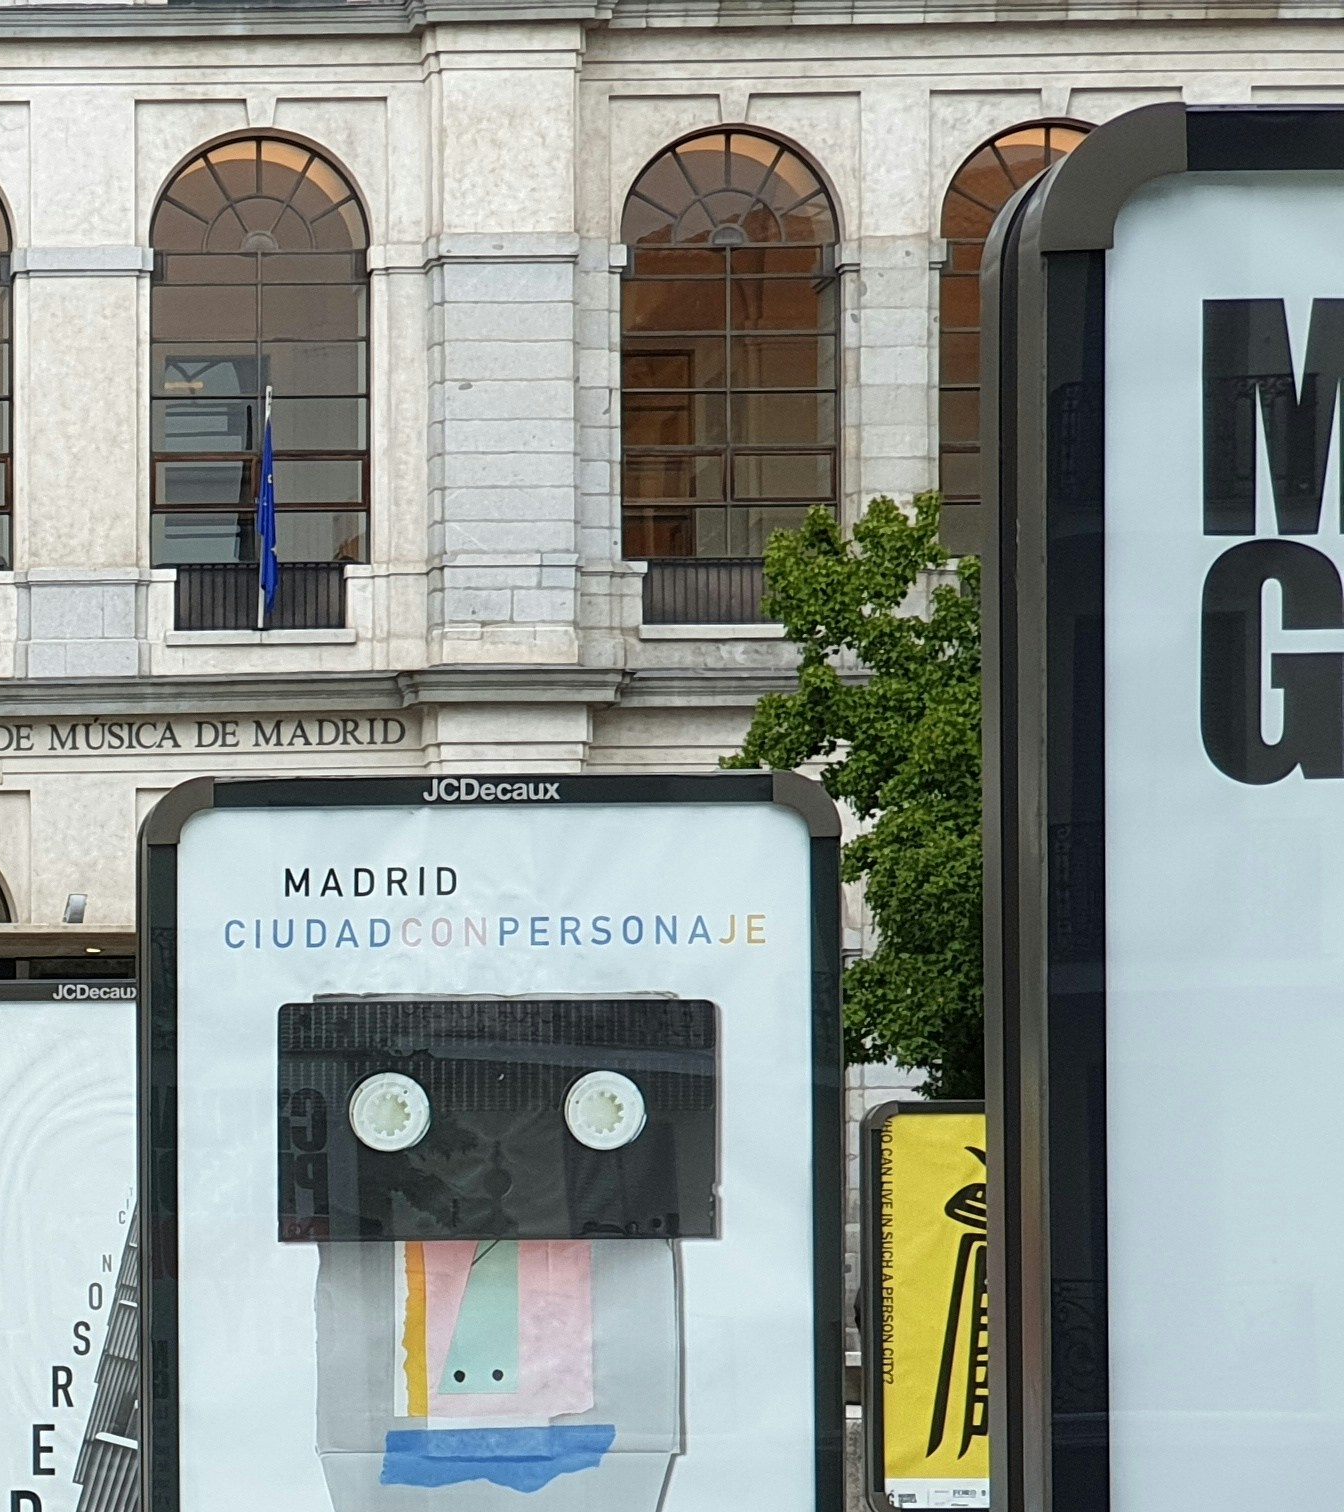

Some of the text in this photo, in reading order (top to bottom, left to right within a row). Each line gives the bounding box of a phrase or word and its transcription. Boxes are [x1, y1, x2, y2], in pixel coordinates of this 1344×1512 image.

[48, 717, 181, 751] MÚSICA
[195, 721, 240, 748] DE
[253, 718, 406, 747] MADRID
[423, 778, 560, 801] JCDecaux
[283, 866, 459, 898] MADRID
[224, 913, 767, 949] CIUDADCONPERSONAJE
